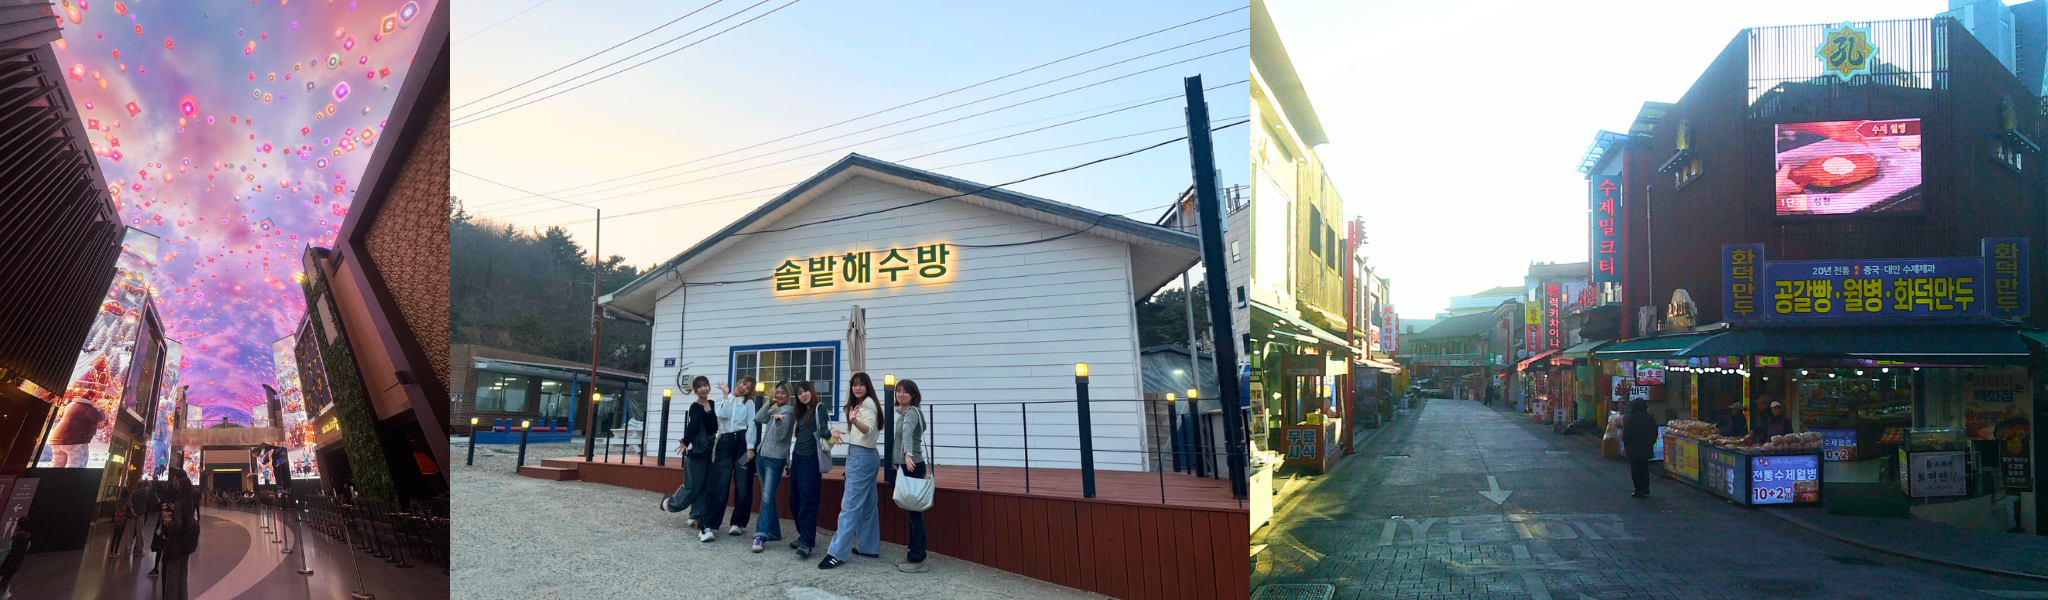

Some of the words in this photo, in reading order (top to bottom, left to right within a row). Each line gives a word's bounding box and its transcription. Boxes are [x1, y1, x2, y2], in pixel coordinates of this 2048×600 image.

[1830, 36, 1863, 67] 孔
[1871, 124, 1888, 135] 수제
[1890, 122, 1906, 134] 월병
[1814, 196, 1831, 206] 성형
[1598, 178, 1616, 276] 수제밀크티
[774, 243, 950, 291] 솔밭해수방
[1812, 266, 1832, 276] 20년
[1833, 266, 1850, 276] 전통
[1902, 264, 1936, 274] 수제제과
[1731, 248, 1755, 317] 화덕만두
[1994, 242, 2020, 313] 화덕만두
[1549, 297, 1560, 348] 럭키차이나
[1974, 374, 2012, 387] 차이나
[1974, 389, 2014, 402] 백화점
[1287, 429, 1317, 444] 무료
[1821, 438, 1852, 447] 수제월병
[1287, 444, 1316, 459] 시식
[1708, 462, 1735, 495] 공갈빵
[1752, 468, 1817, 482] 전통수제월병
[1754, 487, 1784, 500] 10+2
